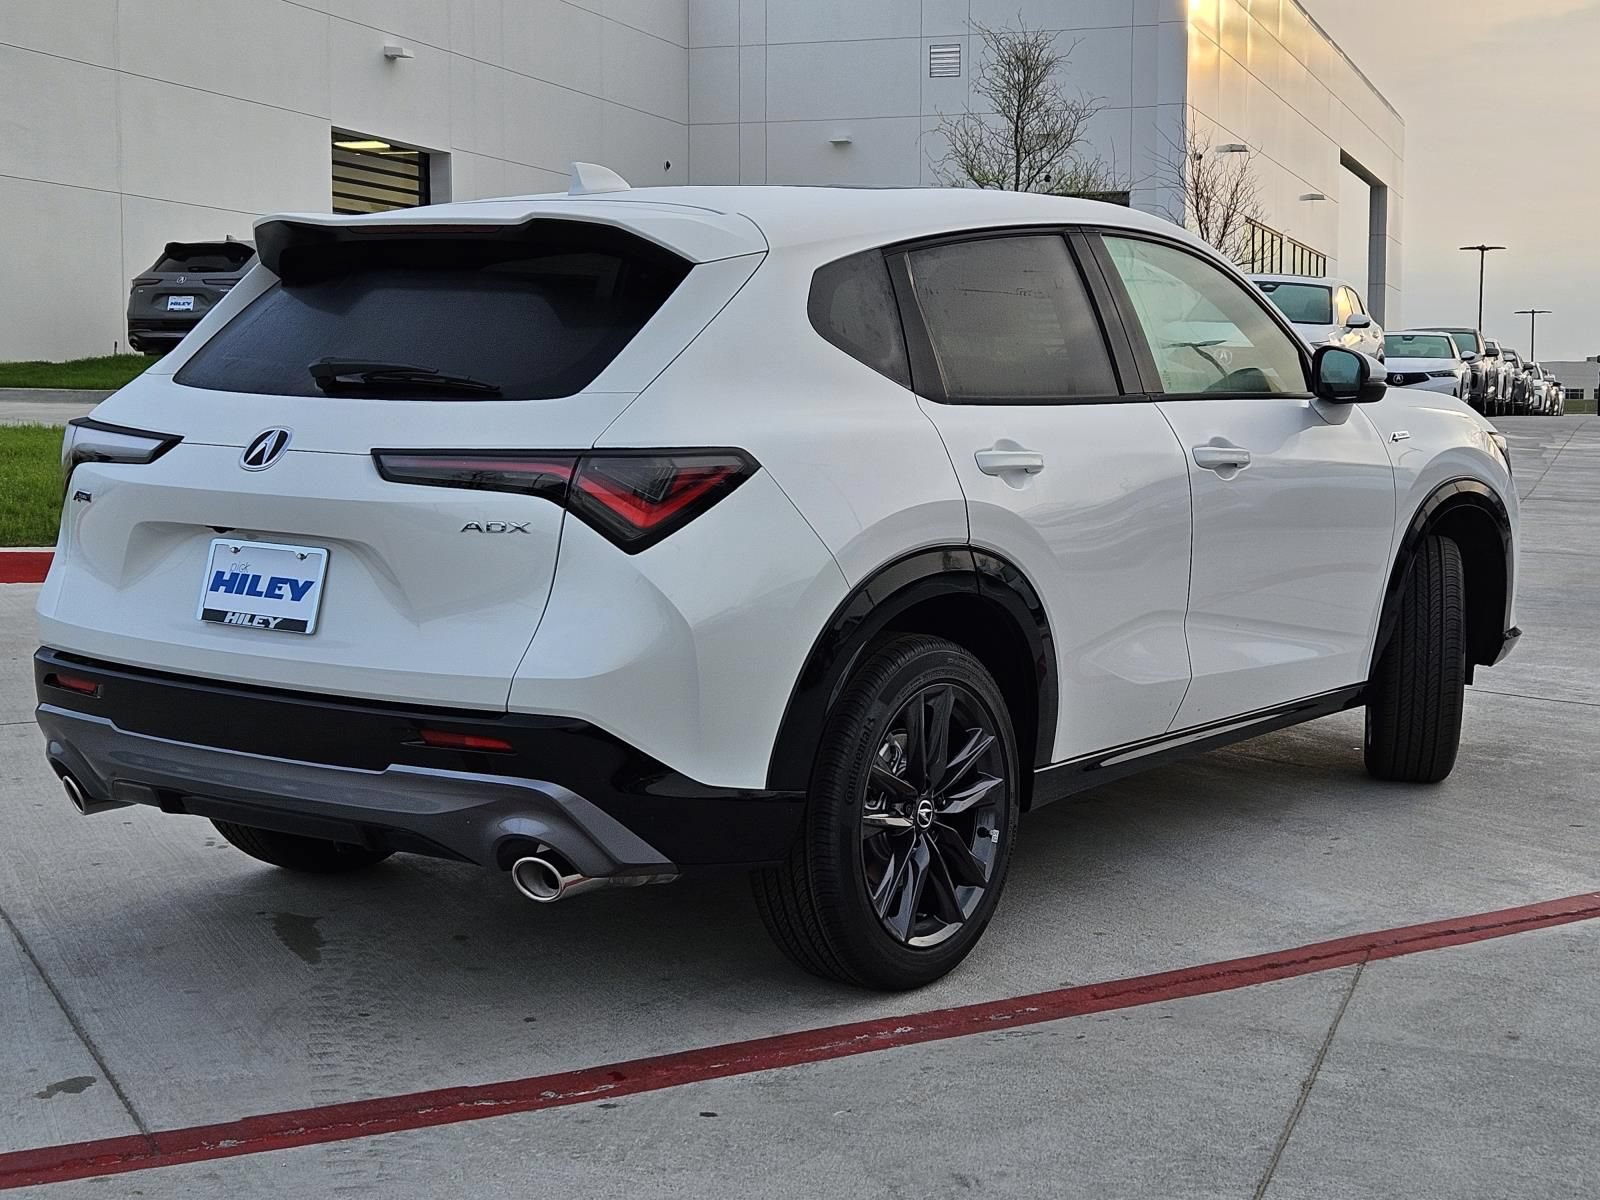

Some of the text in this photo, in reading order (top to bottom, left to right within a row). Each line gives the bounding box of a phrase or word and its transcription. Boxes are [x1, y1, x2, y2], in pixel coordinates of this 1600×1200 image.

[460, 521, 531, 534] ADX
[209, 570, 315, 602] HILEY
[224, 611, 283, 629] HILEY
